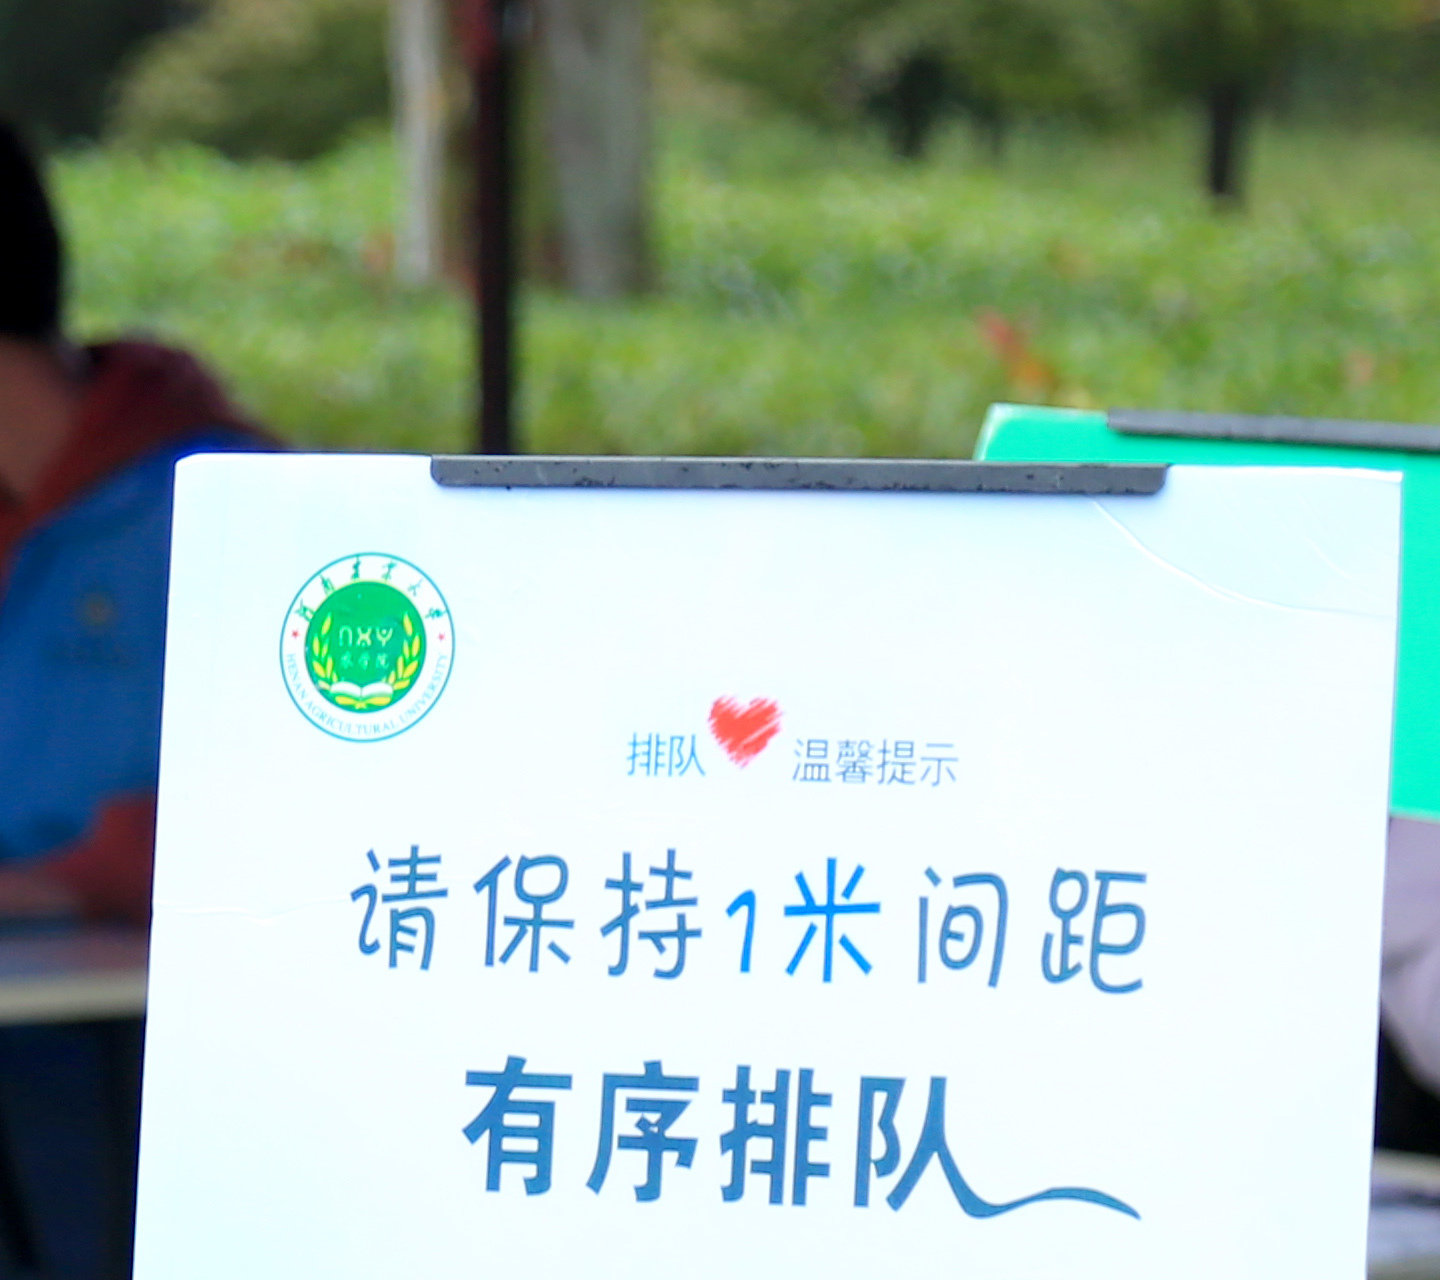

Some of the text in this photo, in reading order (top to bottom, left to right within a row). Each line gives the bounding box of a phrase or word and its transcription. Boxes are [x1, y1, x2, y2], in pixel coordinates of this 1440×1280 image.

[625, 731, 960, 787] 排队 温馨提示
[349, 843, 1148, 995] 请保持1米间距
[461, 1054, 1142, 1220] 有序排队
